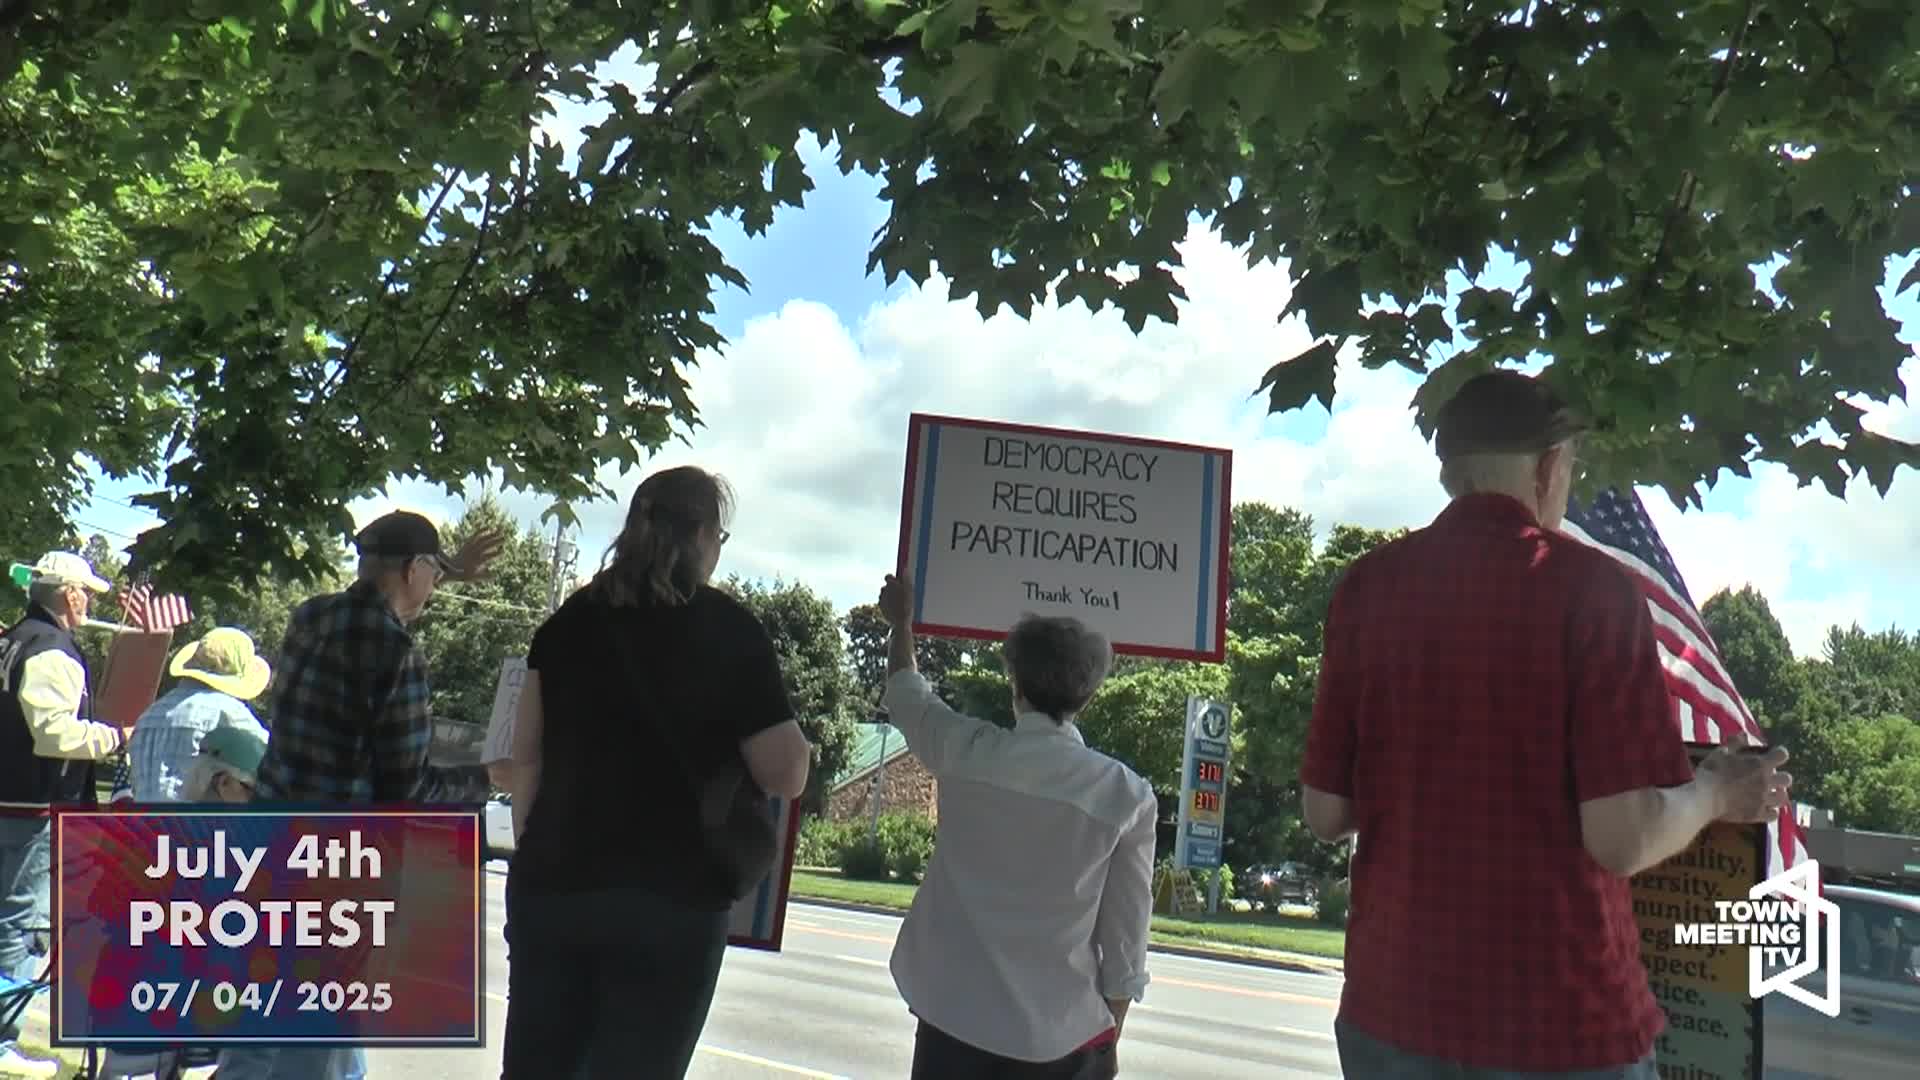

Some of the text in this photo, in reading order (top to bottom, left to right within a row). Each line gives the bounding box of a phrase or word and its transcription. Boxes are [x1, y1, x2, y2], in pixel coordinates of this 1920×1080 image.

[984, 436, 1158, 482] DEMOCRACY
[992, 481, 1137, 524] REQUIRES
[951, 520, 1178, 572] PARTICAPATION
[1021, 581, 1120, 610] Thank You!
[1663, 1005, 1729, 1038] eace.
